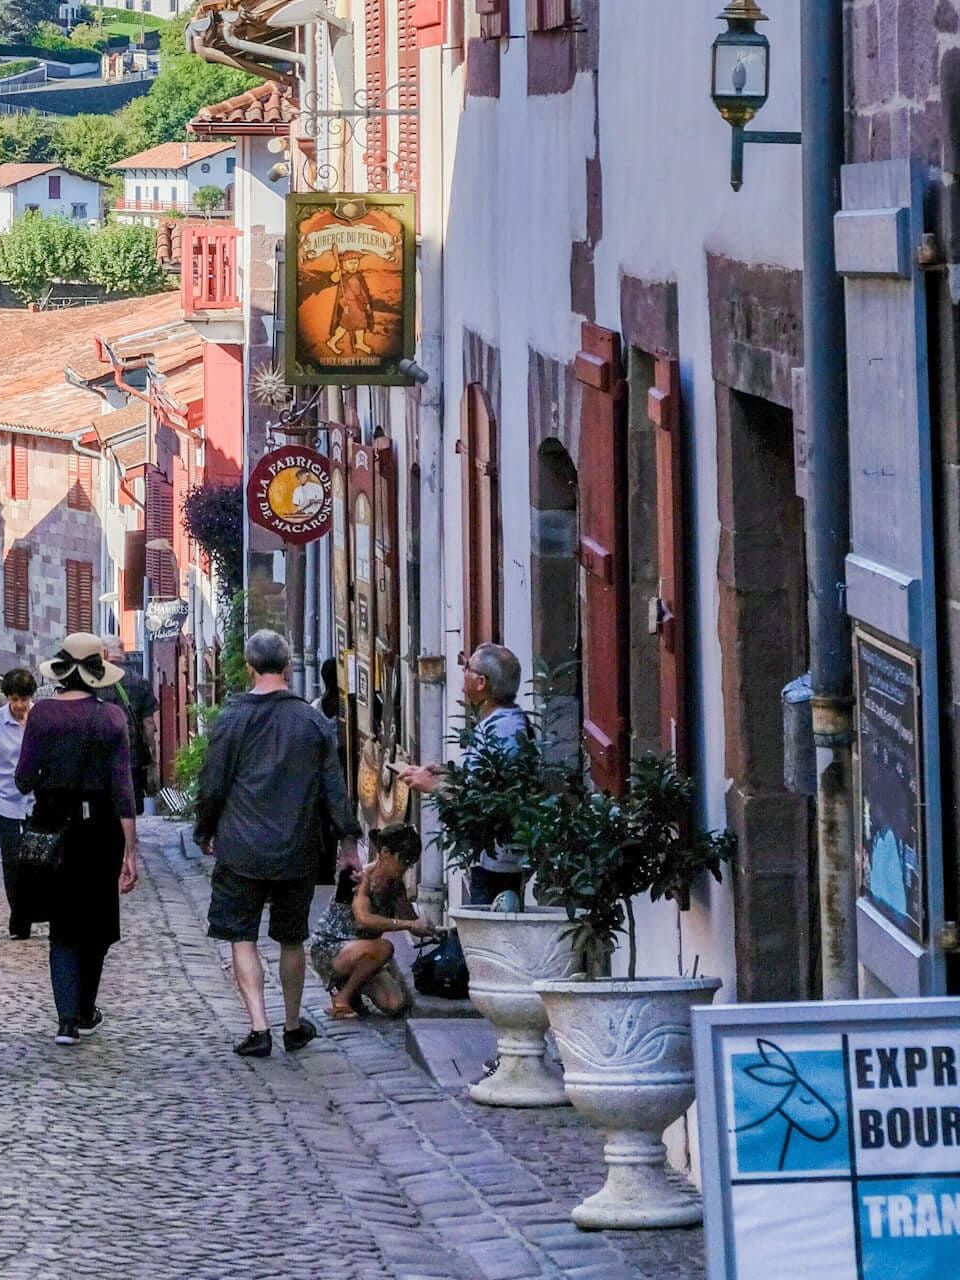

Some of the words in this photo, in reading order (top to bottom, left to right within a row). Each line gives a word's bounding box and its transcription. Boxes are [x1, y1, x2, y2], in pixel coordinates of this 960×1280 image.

[313, 231, 346, 250] AUBERGE
[346, 231, 357, 243] DU
[257, 479, 270, 499] LA
[268, 456, 332, 492] FABRIQUE
[260, 502, 273, 519] DE
[272, 498, 332, 533] MACARONS
